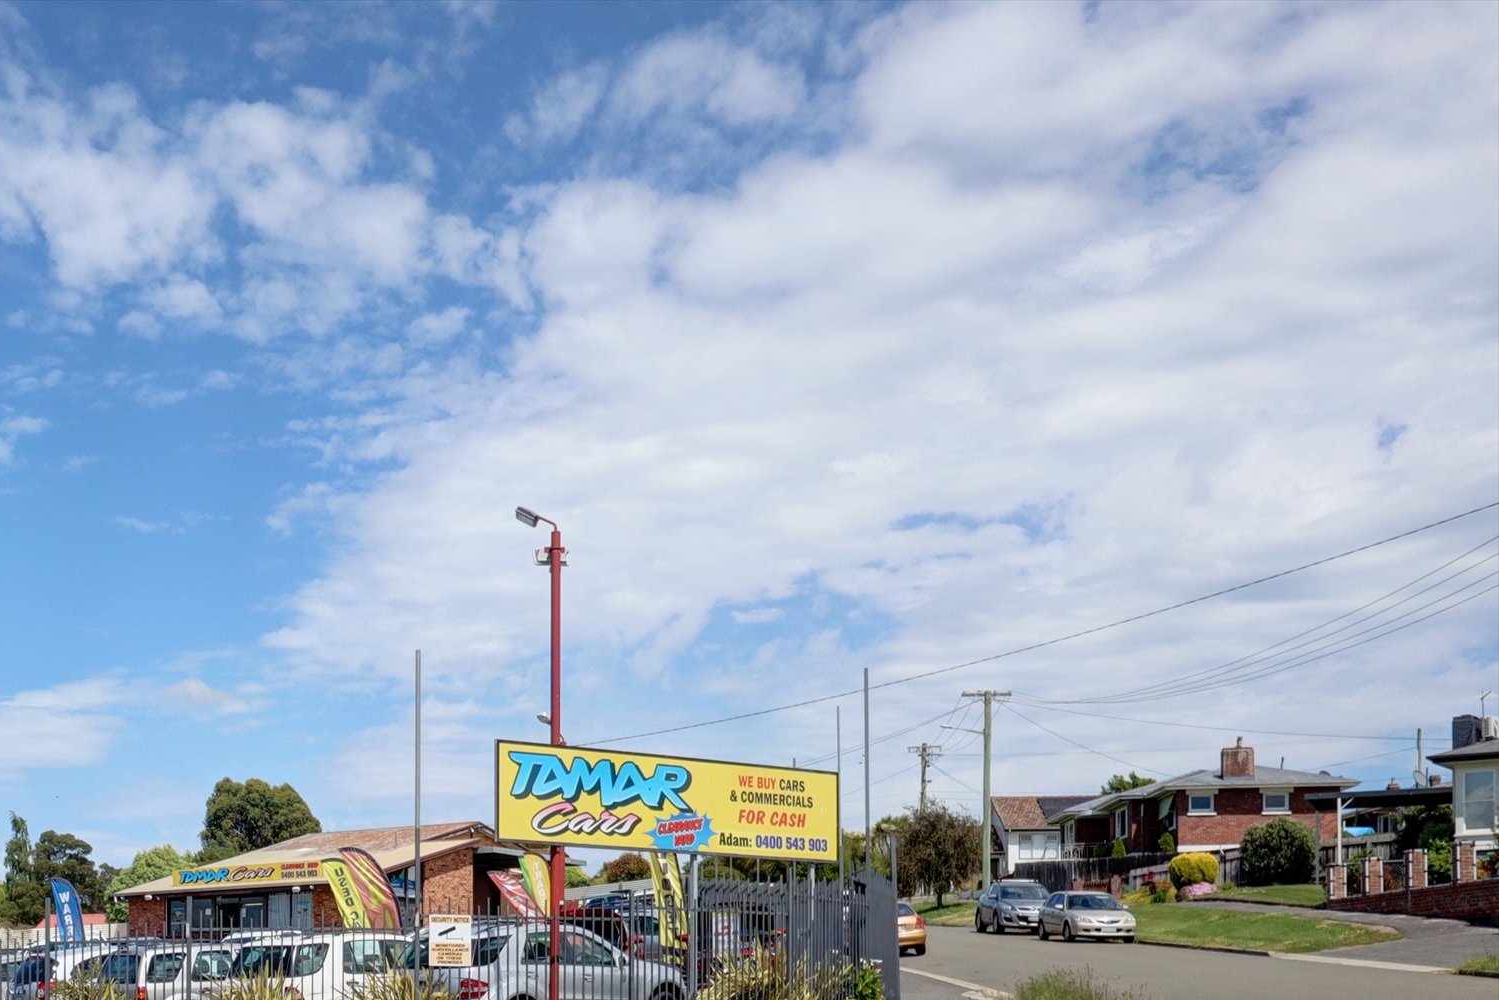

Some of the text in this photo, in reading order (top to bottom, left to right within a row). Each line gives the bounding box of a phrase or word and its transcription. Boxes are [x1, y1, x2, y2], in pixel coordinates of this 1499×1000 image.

[508, 751, 693, 813] TAMAR
[738, 775, 805, 792] WE BUY CARS
[730, 790, 813, 808] & COMMERCIALS
[531, 801, 642, 836] Cars
[657, 817, 705, 835] CLEARANCE
[738, 809, 806, 828] FOR CASH
[674, 833, 695, 848] YARD
[719, 832, 828, 852] Adam: 0400 543 903
[179, 865, 276, 884] TAMAR Cars
